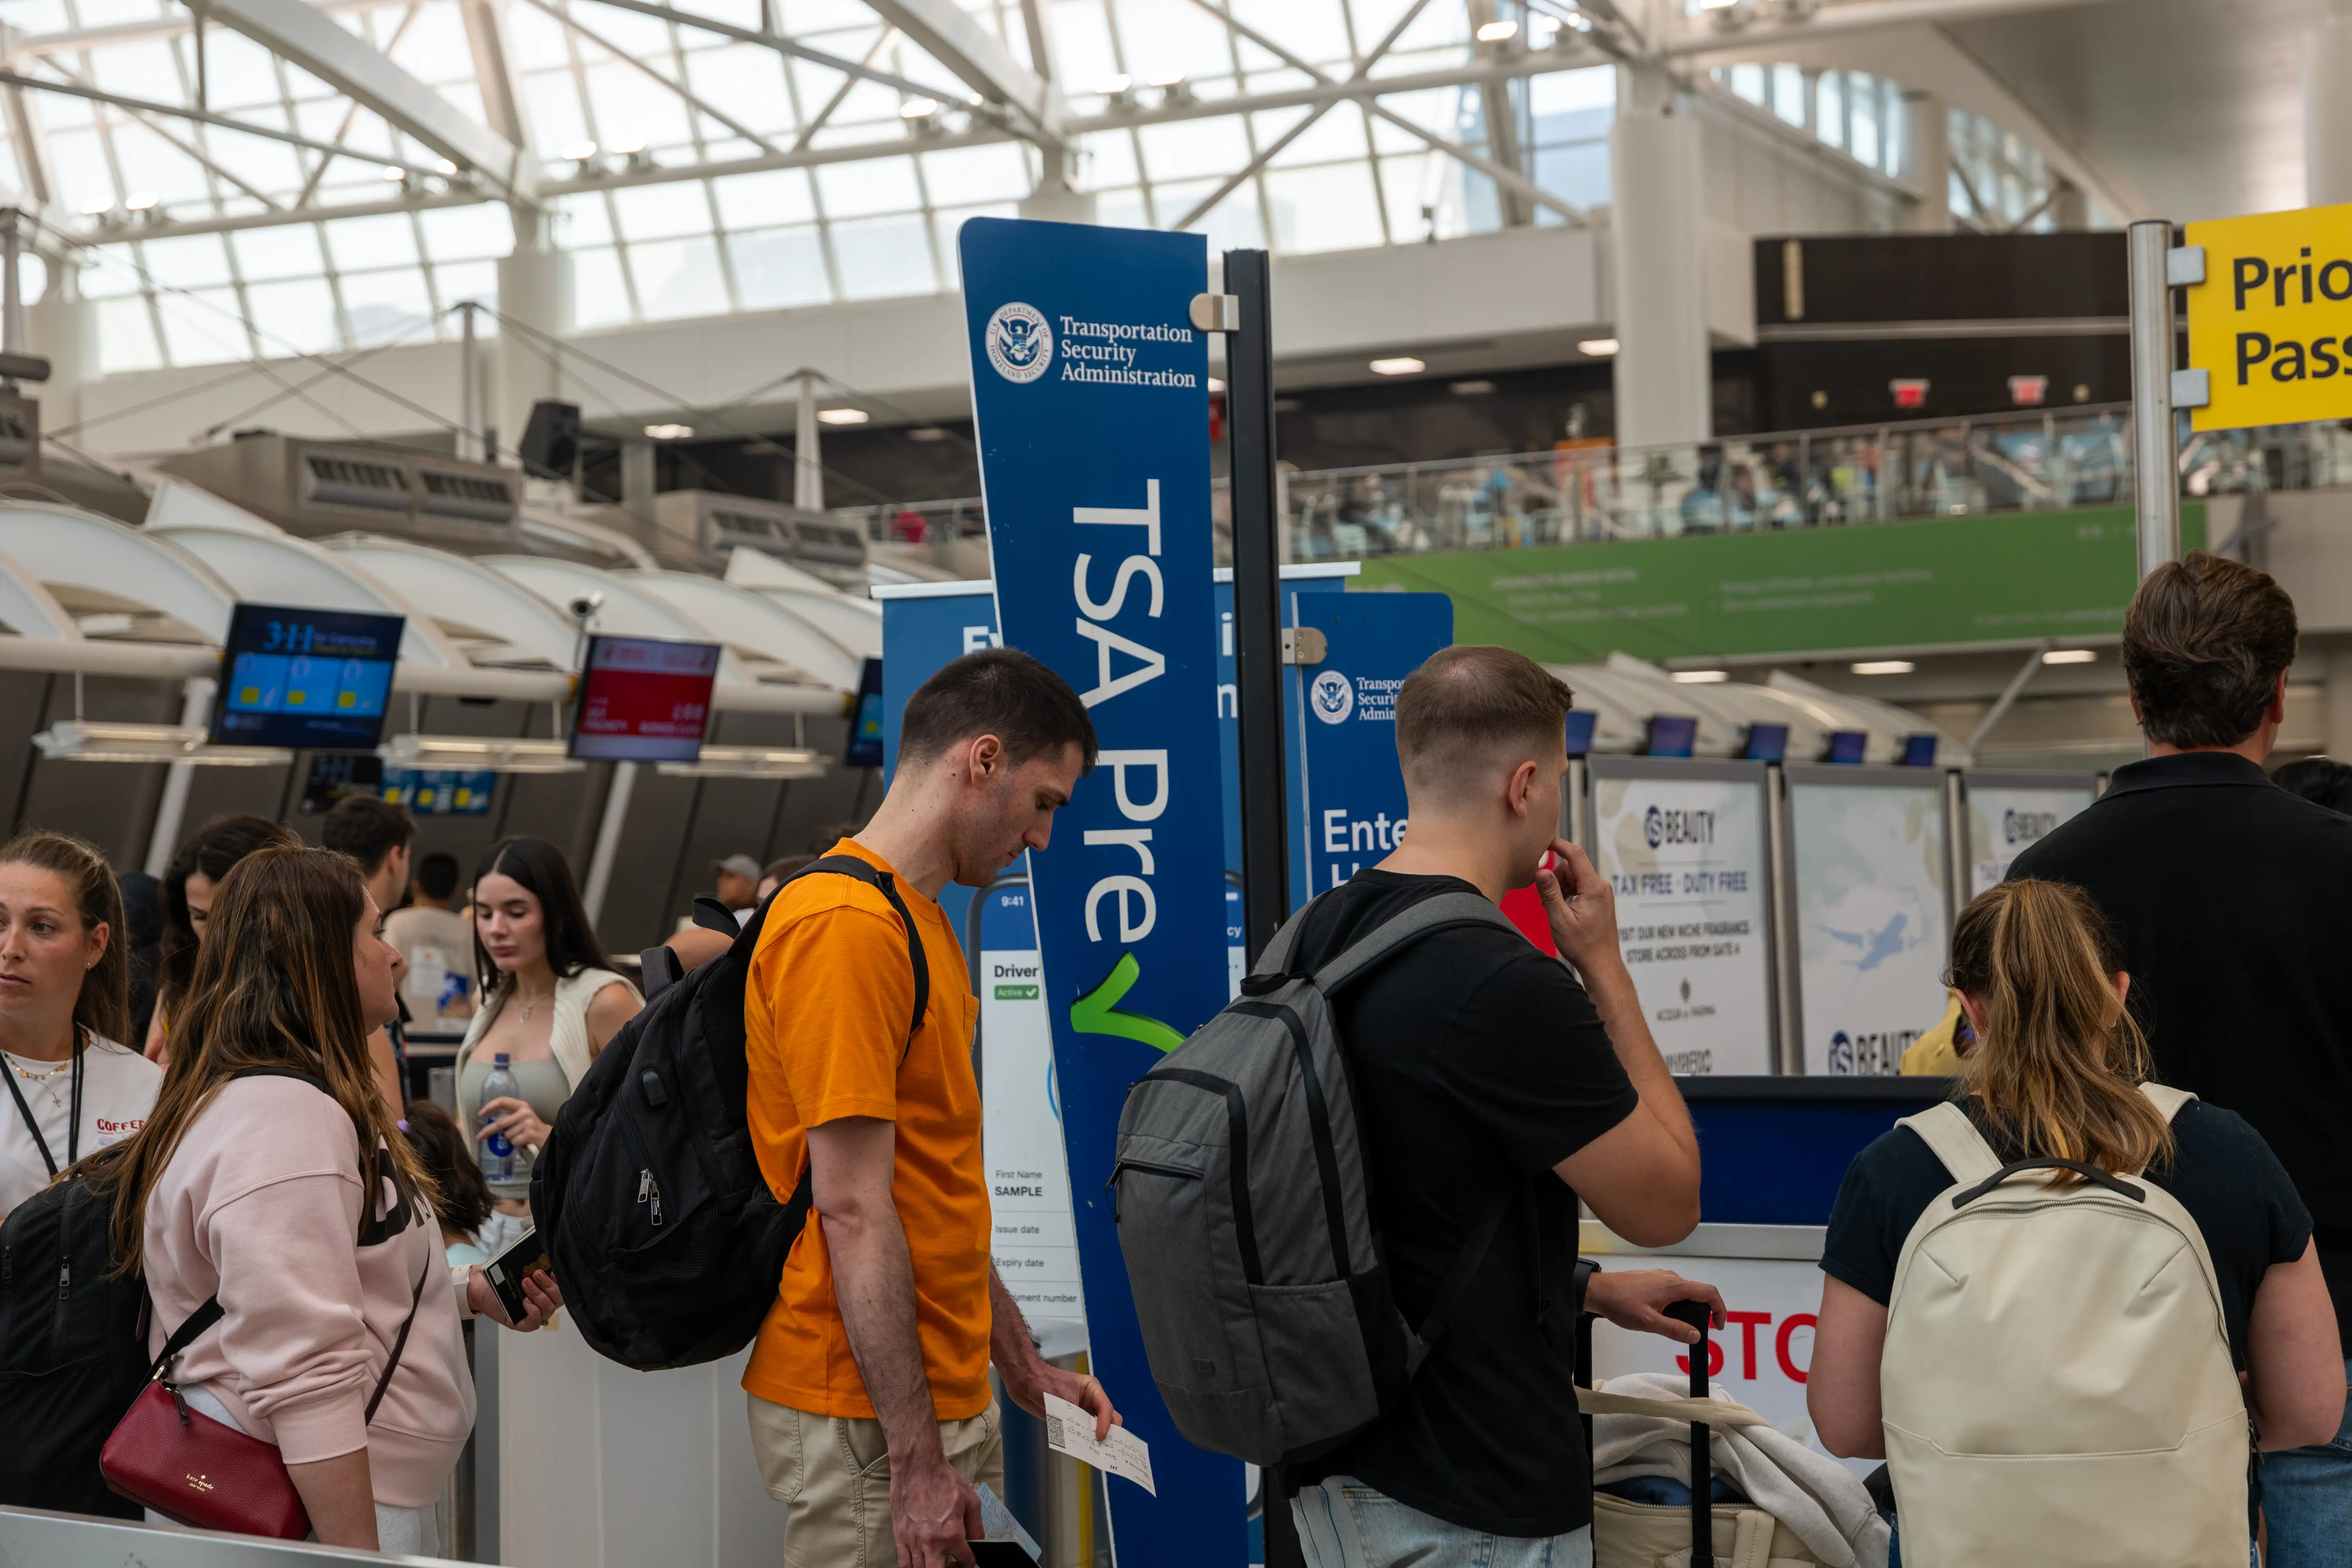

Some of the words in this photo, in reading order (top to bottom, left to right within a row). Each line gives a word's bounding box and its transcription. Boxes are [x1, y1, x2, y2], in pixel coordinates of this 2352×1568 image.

[2234, 247, 2352, 310] Prio
[1060, 315, 1193, 344] Transportation
[1061, 339, 1137, 368] Security
[1061, 361, 1197, 388] Administration
[1073, 479, 1165, 708] TSA
[1665, 810, 1715, 844] BEAUTY
[1083, 749, 1169, 943] Pre
[1613, 874, 1638, 896] TAX
[1642, 873, 1672, 894] FREE
[1684, 871, 1715, 894] DUTY
[1719, 870, 1748, 892] FREE
[1001, 895, 1024, 907] 9:41
[997, 988, 1024, 998] Active
[996, 1171, 1015, 1179] First
[1017, 1171, 1043, 1179] Name
[995, 1187, 1043, 1196] SAMPLE
[996, 1225, 1018, 1234] Issue
[1020, 1225, 1040, 1234] date
[996, 1258, 1022, 1268] Expiry
[1025, 1258, 1045, 1267] date
[1043, 1294, 1078, 1303] number
[186, 1474, 198, 1482] kate
[198, 1481, 214, 1490] spade
